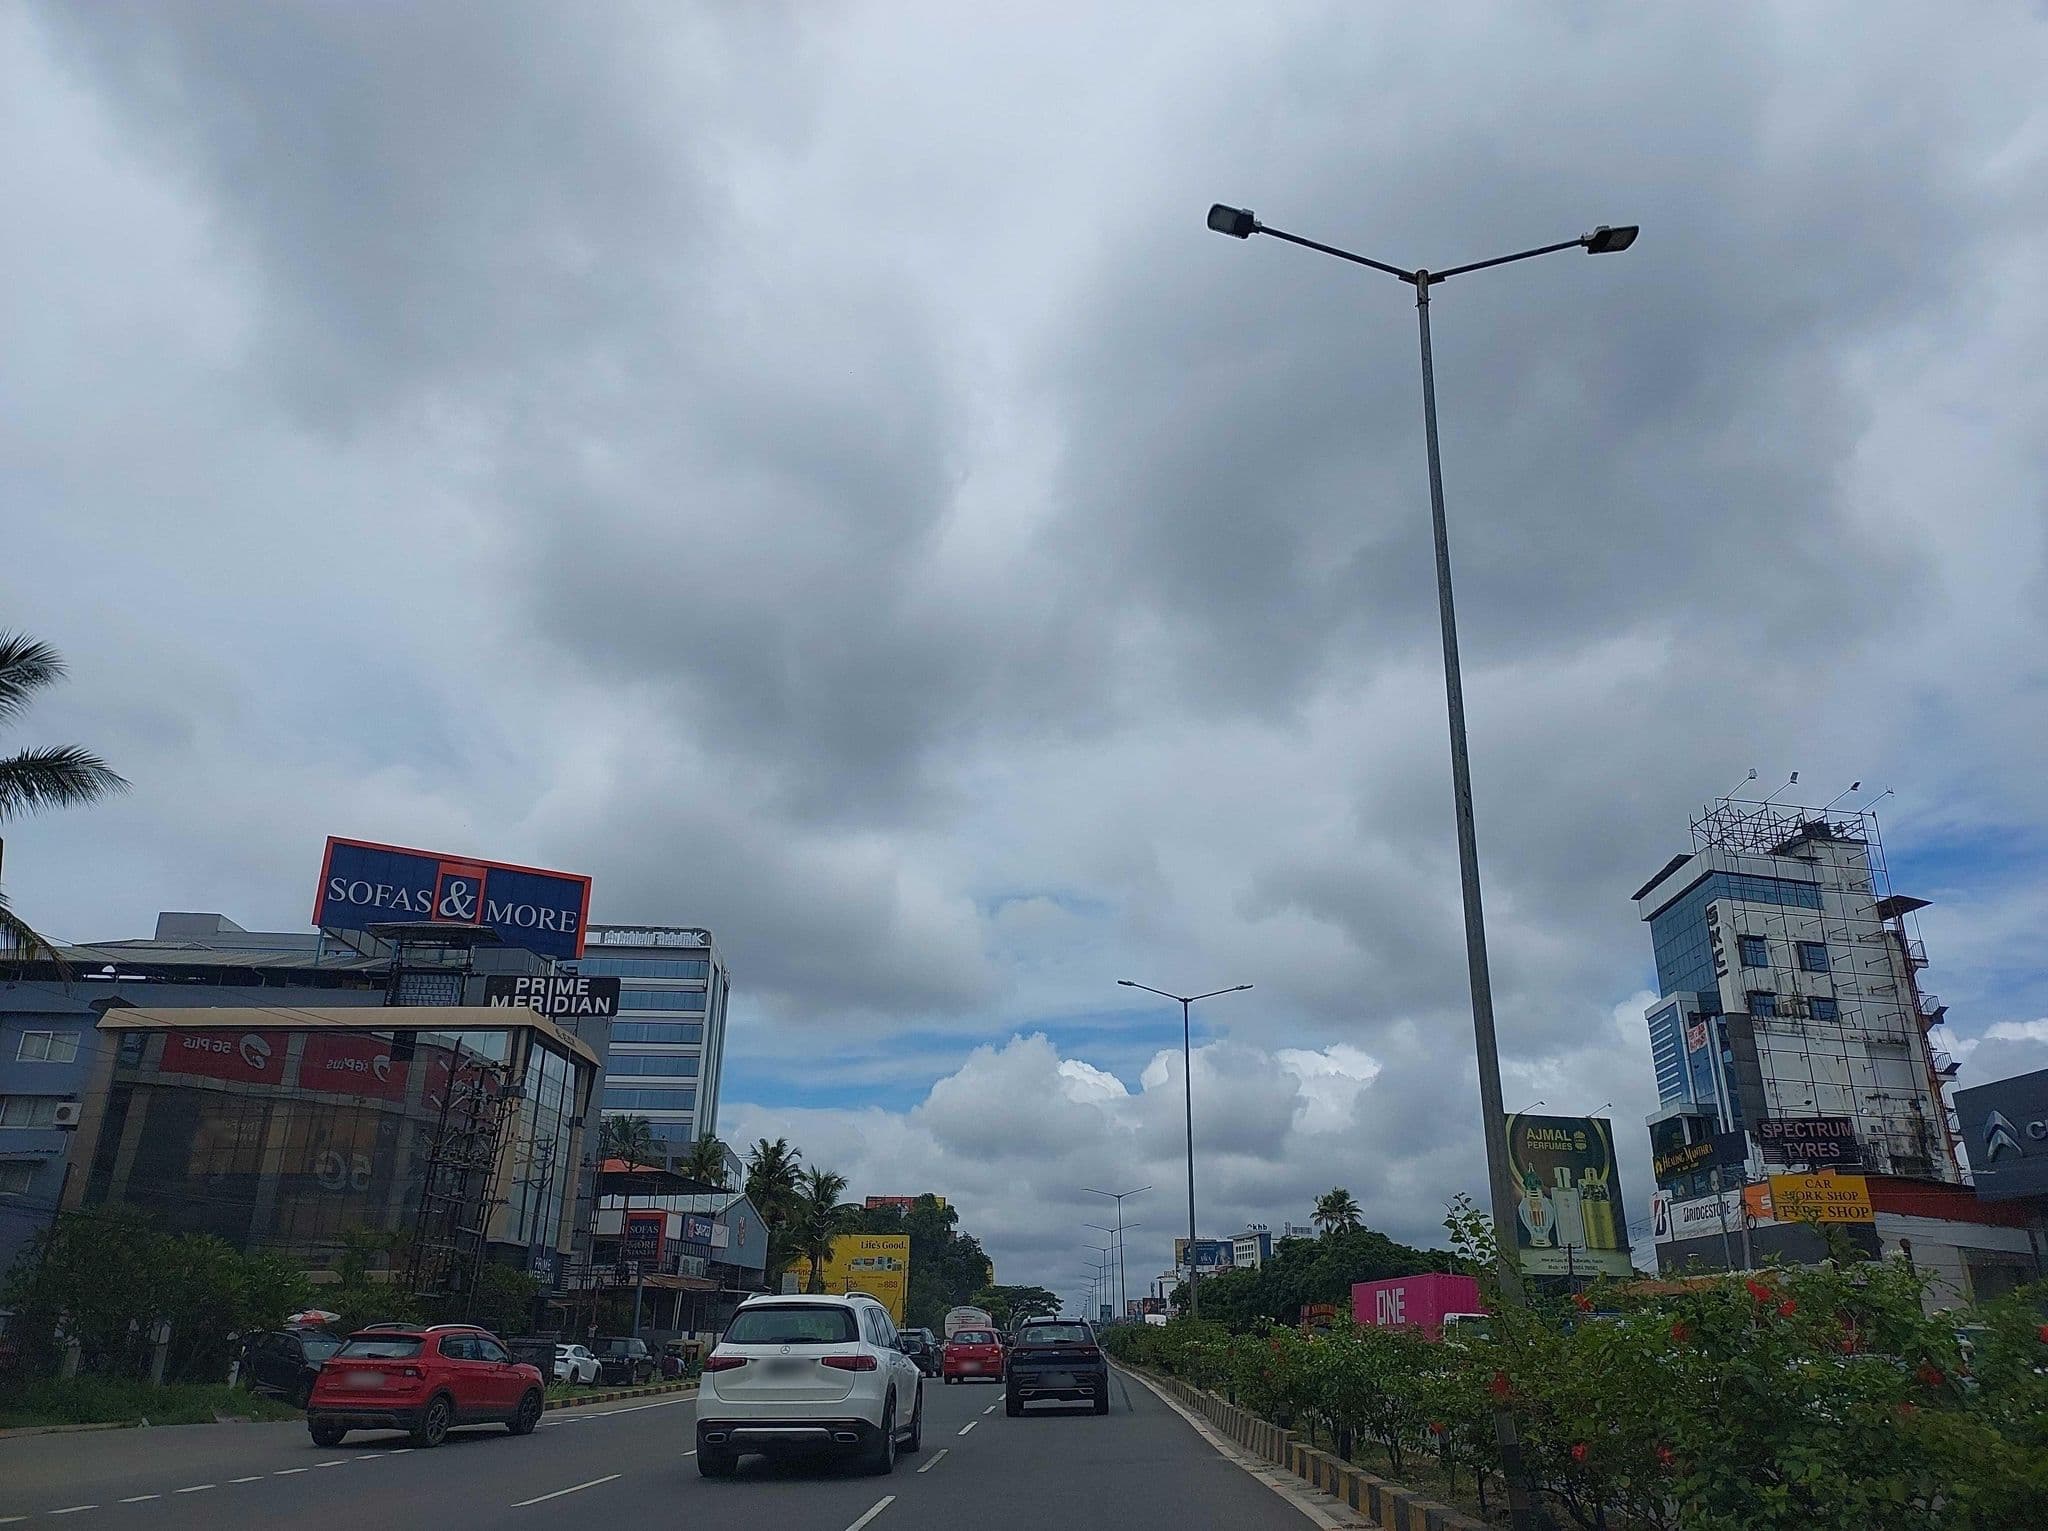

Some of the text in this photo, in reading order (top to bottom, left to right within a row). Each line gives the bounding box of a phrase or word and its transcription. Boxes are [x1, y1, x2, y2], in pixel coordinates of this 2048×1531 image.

[328, 877, 577, 934] SOFAS & MORE
[515, 977, 590, 996] PRIME
[490, 995, 611, 1015] MERIDIAN
[1526, 1128, 1572, 1142] AJMAL
[1761, 1120, 1855, 1139] SPECTRUM
[1527, 1141, 1573, 1151] PERFUMES
[1783, 1142, 1840, 1158] TYRES
[1804, 1178, 1832, 1189] CAR
[1826, 1191, 1859, 1201] SHOP
[1827, 1206, 1869, 1218] SHOP
[628, 1224, 660, 1234] SOFAS
[861, 1240, 906, 1249] Life's Good.
[1376, 1288, 1405, 1325] ONE
